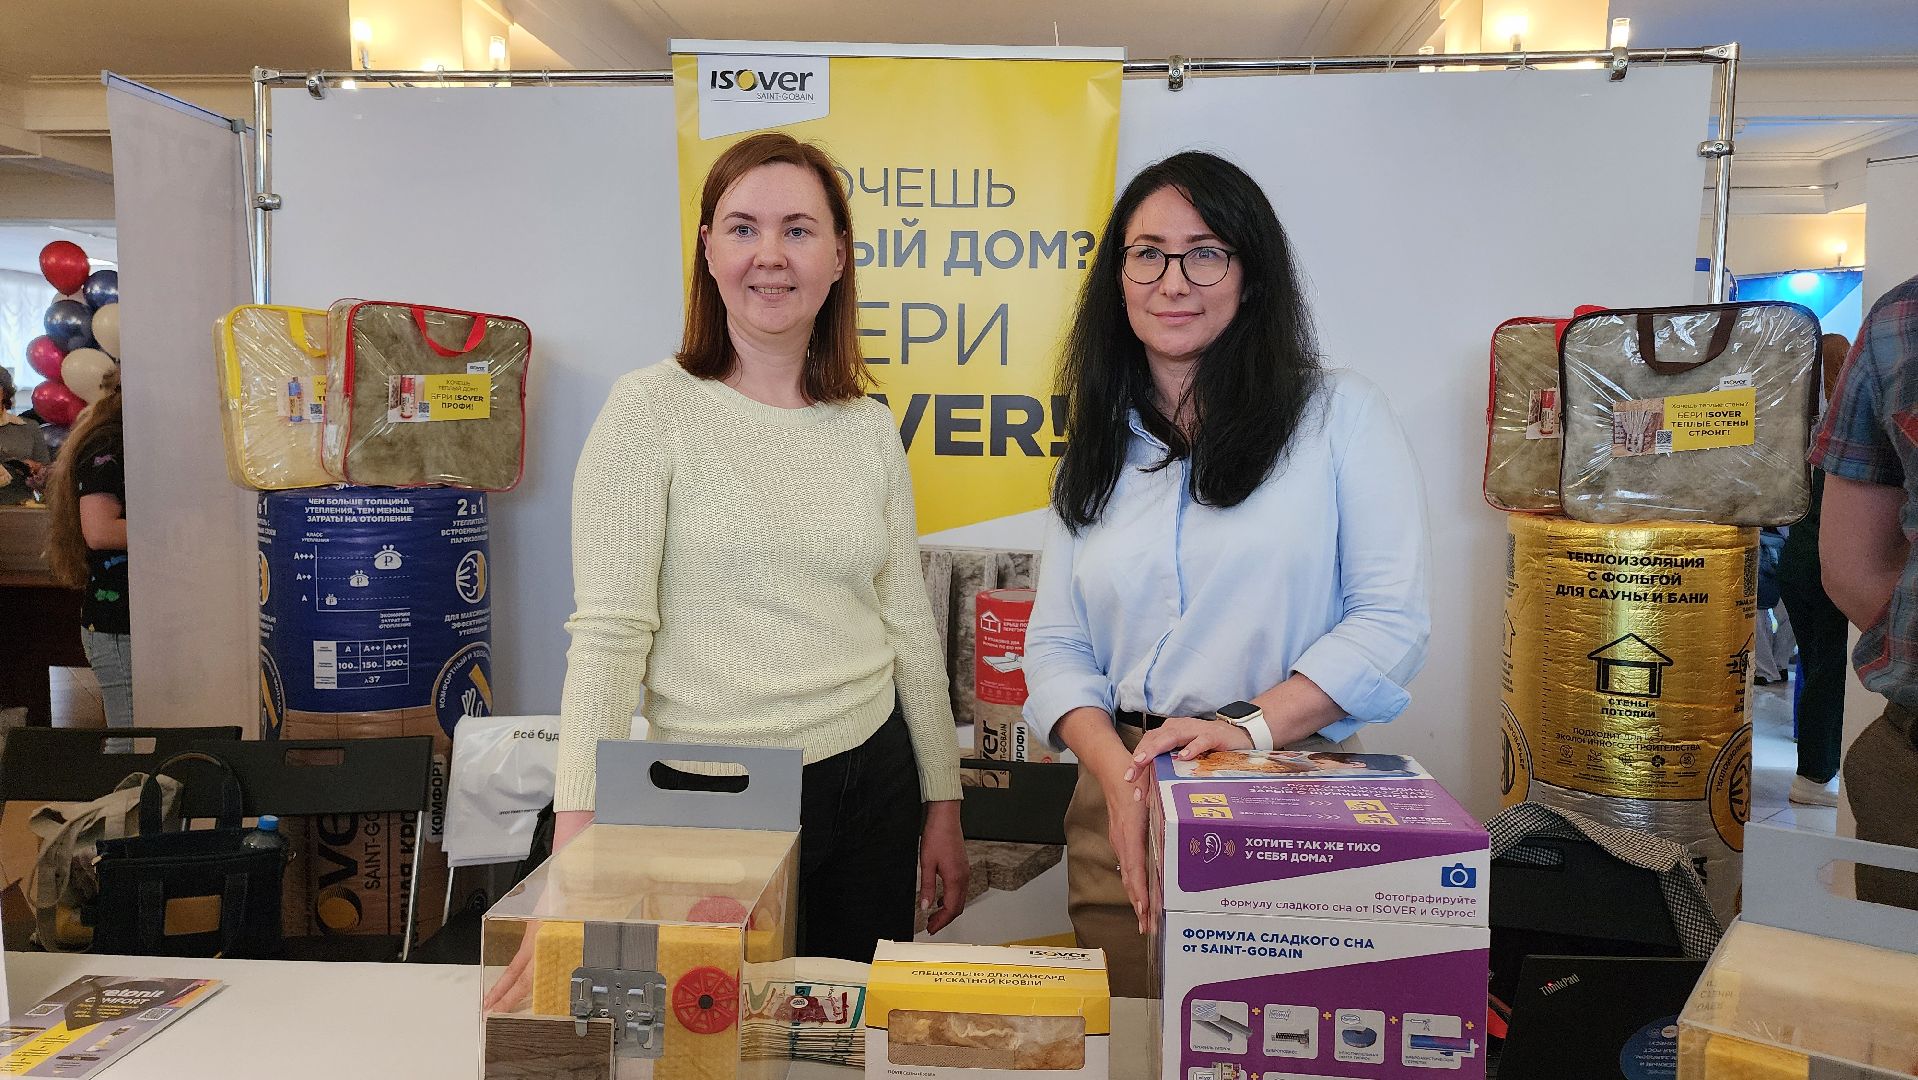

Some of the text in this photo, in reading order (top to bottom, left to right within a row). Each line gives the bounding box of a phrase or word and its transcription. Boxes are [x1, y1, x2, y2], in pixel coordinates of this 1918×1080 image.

[756, 92, 814, 101] SAINT-GOBAIN
[834, 167, 1016, 208] ОЧЕШЬ
[943, 230, 1096, 276] ДОМ?
[856, 301, 1010, 366] ЕРИ
[441, 402, 474, 410] ПРОФИ!
[1705, 410, 1741, 418] ISOVER
[877, 393, 1070, 457] VER!
[364, 498, 410, 506] ТОЛЩИНА
[457, 499, 468, 516] 2
[478, 496, 484, 513] 1
[304, 507, 356, 515] УТЕПЛЕНИЯ,
[359, 515, 412, 523] ОТОПЛЕНИЕ
[1566, 550, 1705, 569] ТЕПЛОИЗОЛЯЦИЯ
[1587, 569, 1682, 586] С ФОЛЬГОЙ
[1556, 584, 1709, 604] ДЛЯ САУНЫ И БАНИ
[1608, 698, 1649, 708] СТЕНЫ
[1601, 707, 1656, 719] ПОТОЛКИ
[538, 729, 559, 742] буд
[431, 761, 443, 836] КОМФОРТ
[363, 813, 380, 890] SAINT-GO
[1245, 837, 1381, 852] ХОТИТЕ ТАК ЖЕ ТИХО
[1245, 850, 1334, 863] У СЕБЯ ДОМА?
[1374, 891, 1477, 907] Фотографируйте
[1220, 897, 1272, 911] формулу
[1275, 901, 1329, 913] сладкого
[1332, 904, 1352, 913] сна
[1372, 905, 1417, 916] ISOVER
[1420, 908, 1428, 916] и
[1431, 907, 1476, 920] Gyproc!
[1182, 927, 1375, 950] ФОРМУЛА СЛАДКОГО СНА
[1182, 943, 1303, 959] от SAINT-GOBAIN
[911, 969, 1066, 982] СПЕЦИАЛЬНО ДЛЯ МАНСАРД
[945, 976, 996, 985] СКАТНОЙ
[998, 978, 1042, 987] КРОВЛИ
[1539, 973, 1581, 997] ThinkPad
